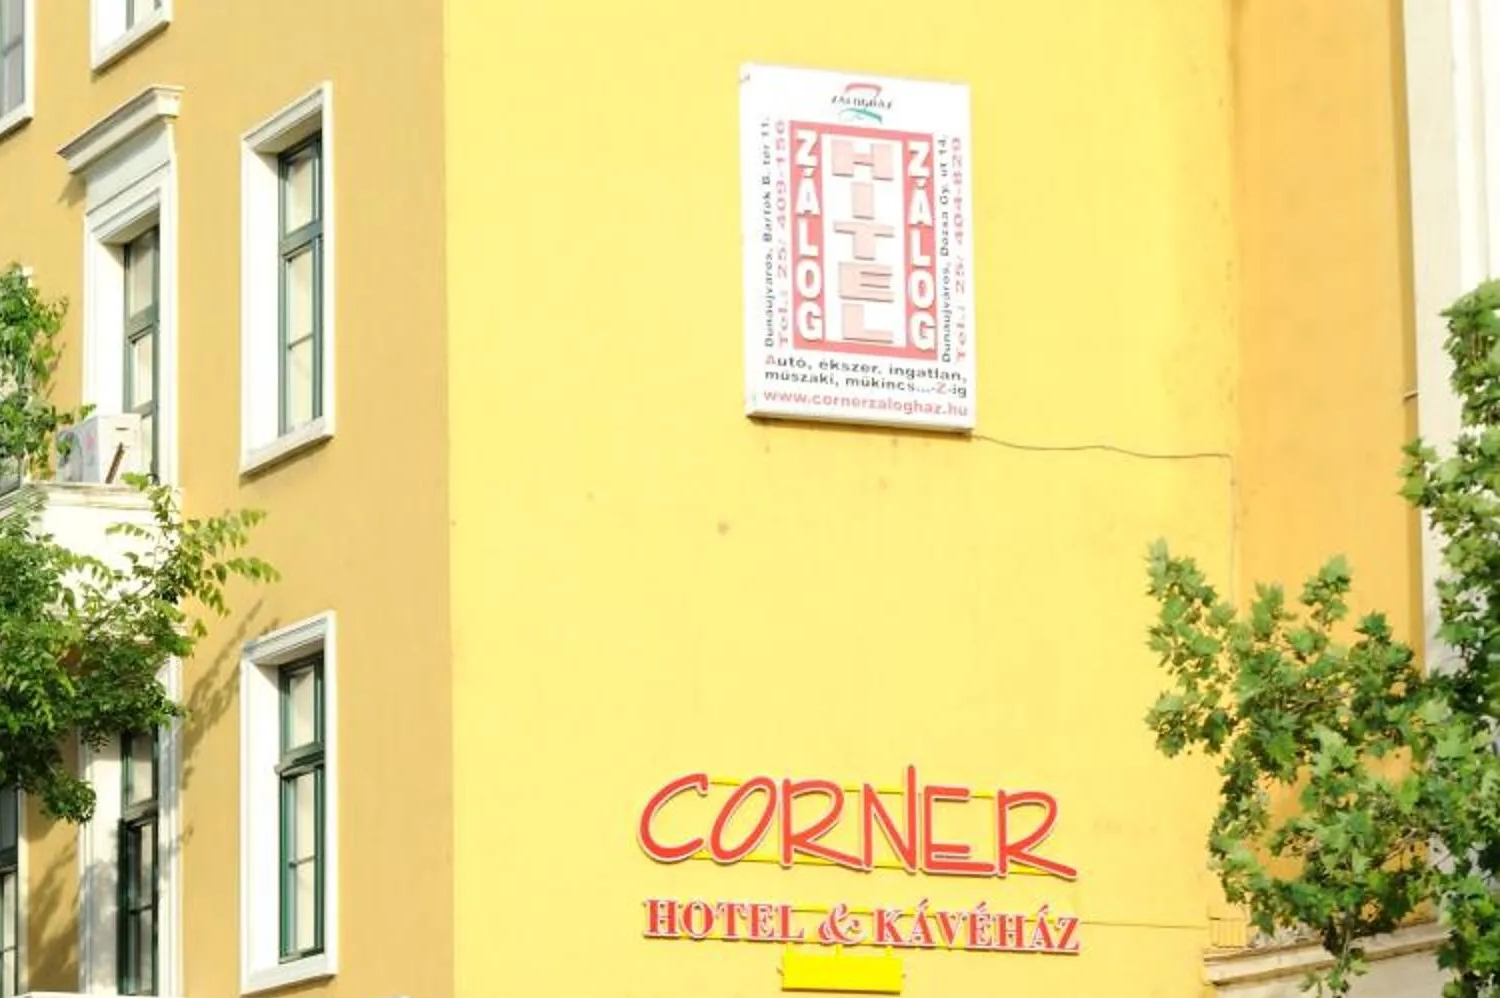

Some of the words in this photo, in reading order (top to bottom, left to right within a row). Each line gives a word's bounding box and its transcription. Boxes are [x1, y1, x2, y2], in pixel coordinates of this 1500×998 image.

[796, 130, 822, 341] ZÁLOG
[831, 139, 894, 343] HITEL
[908, 141, 935, 352] ZÁLOG
[637, 764, 1078, 881] CORNER
[643, 898, 804, 942] HOTEL
[818, 903, 865, 945] &
[875, 897, 1080, 955] KÁVÉHÁZ
